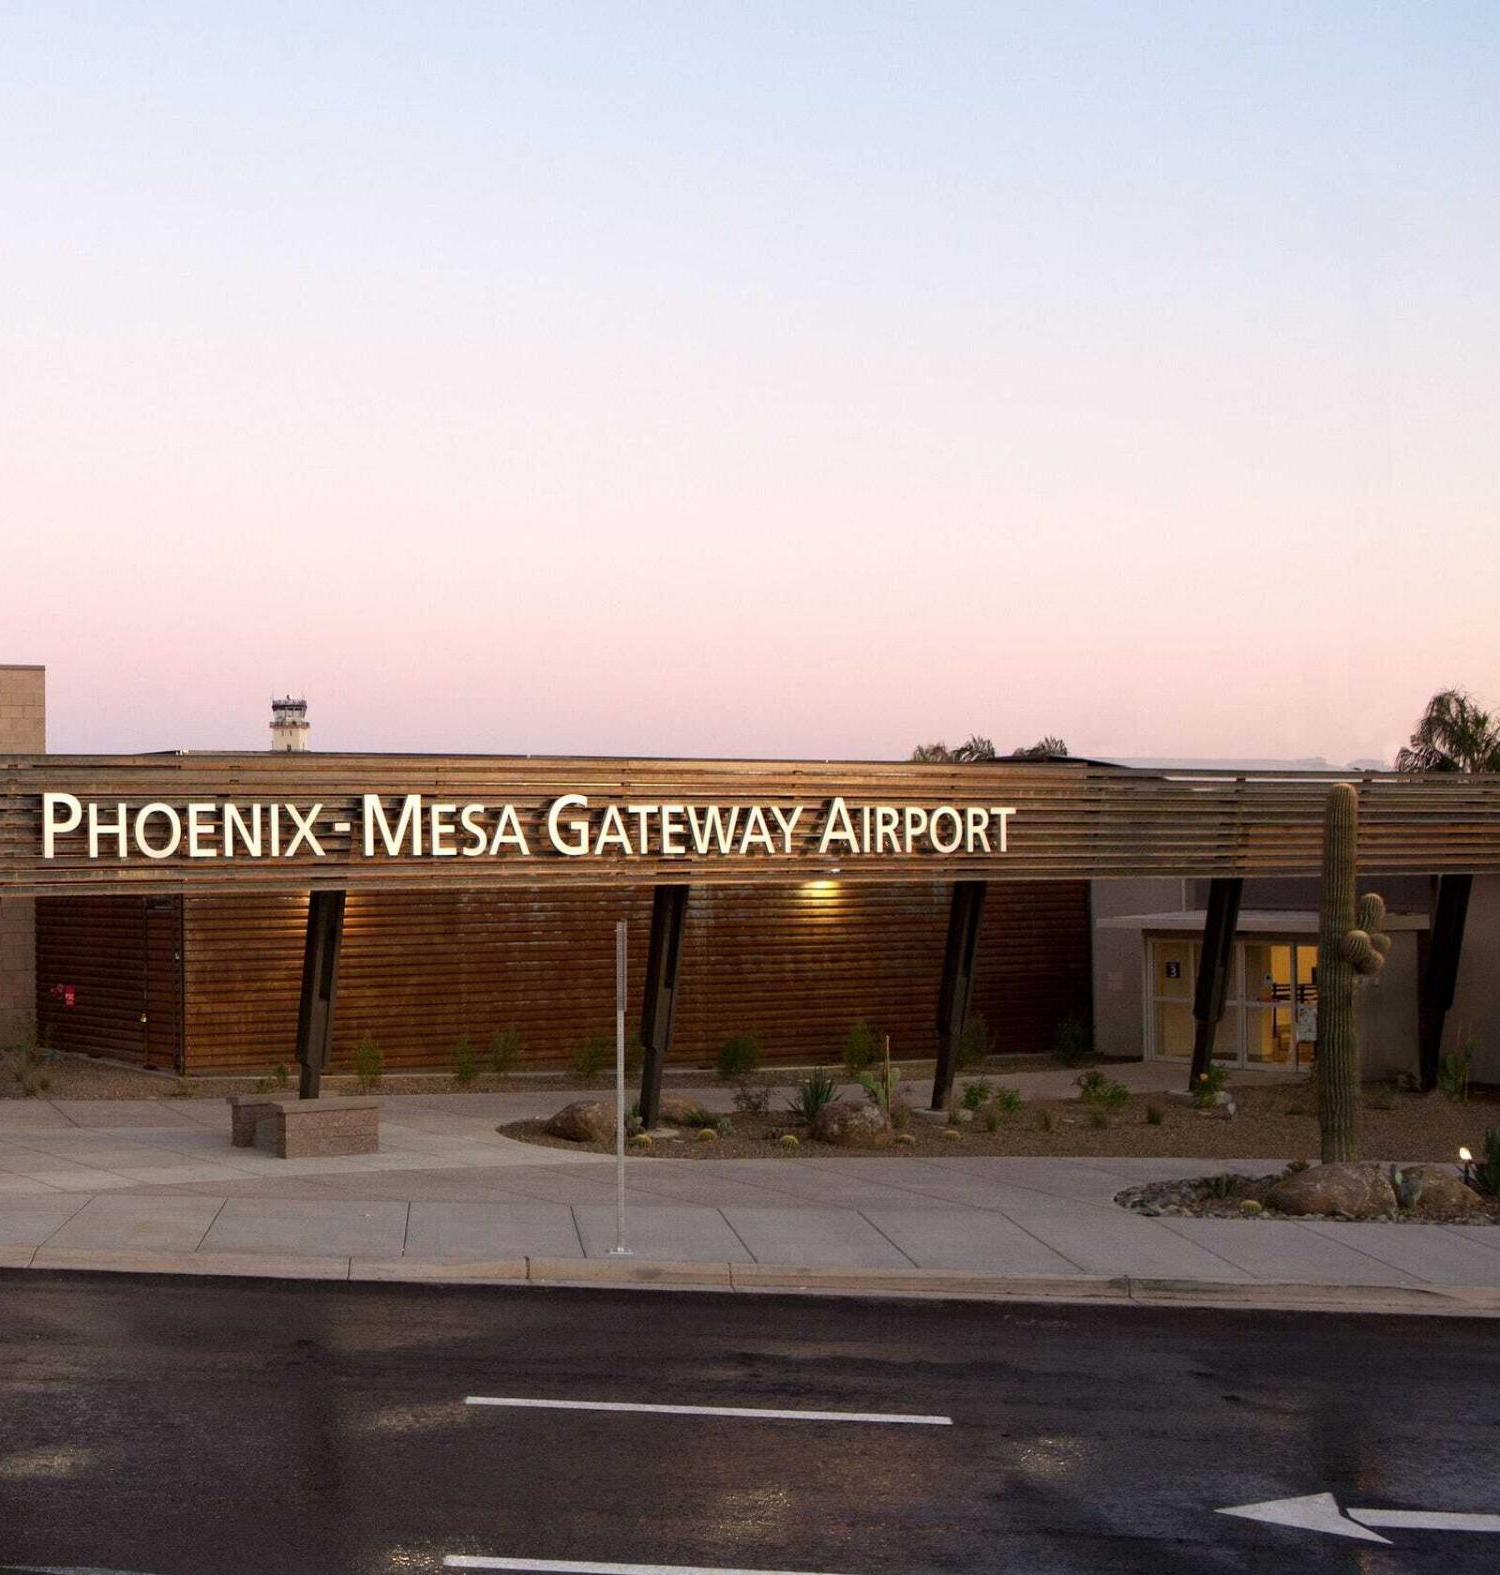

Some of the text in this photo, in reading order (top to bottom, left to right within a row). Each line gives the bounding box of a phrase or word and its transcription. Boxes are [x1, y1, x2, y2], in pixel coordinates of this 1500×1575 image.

[547, 794, 803, 857] GATEWAY
[818, 796, 1017, 855] AIRPORT
[1171, 966, 1177, 977] 3
